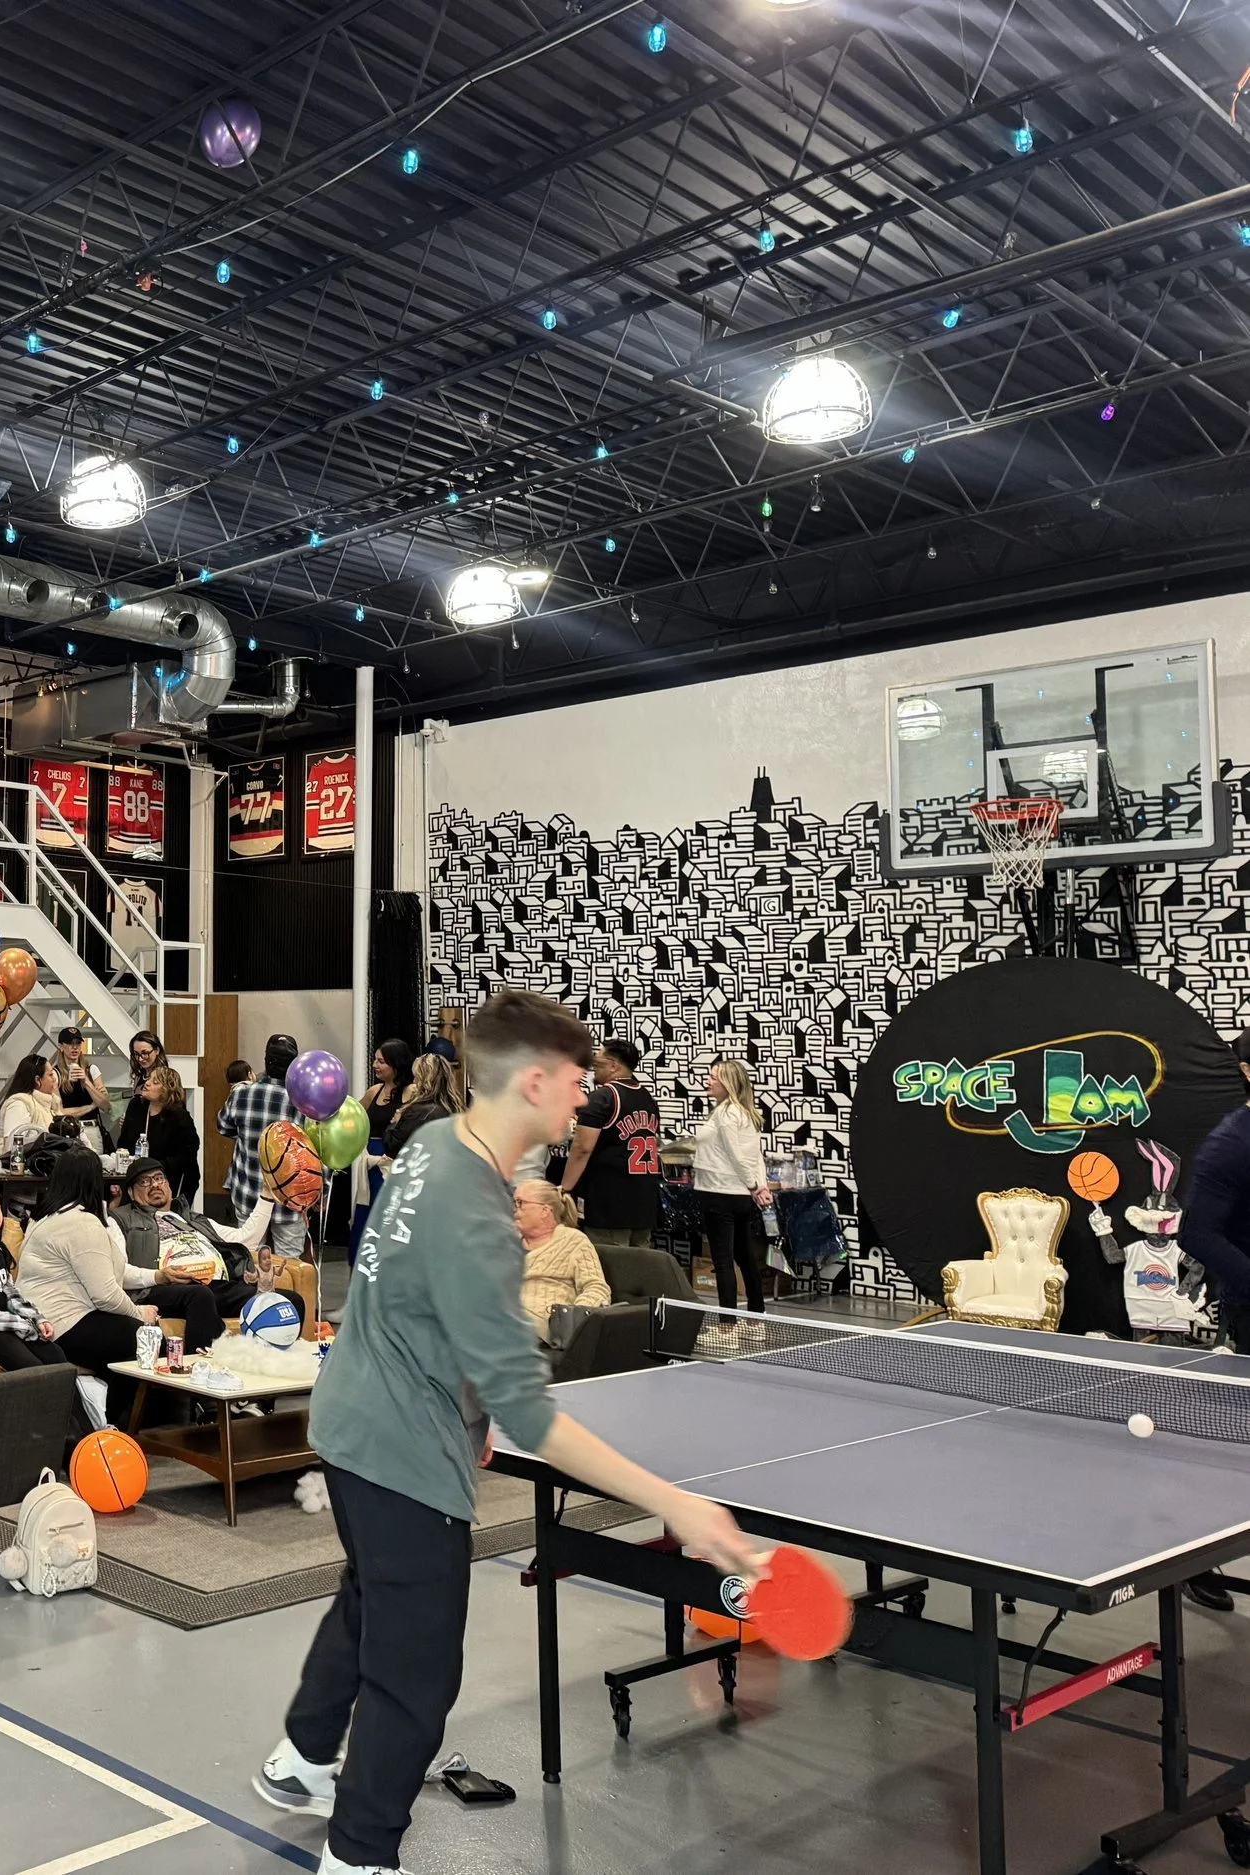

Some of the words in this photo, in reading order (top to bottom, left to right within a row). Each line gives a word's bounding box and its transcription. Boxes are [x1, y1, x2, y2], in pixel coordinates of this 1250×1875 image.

[33, 771, 40, 782] 7
[47, 769, 72, 781] CHELIOS
[109, 775, 121, 787] 88
[323, 773, 349, 786] ROENICK
[79, 777, 86, 788] 7
[130, 779, 144, 789] KANE
[152, 780, 164, 791] 88
[246, 780, 264, 791] CORVO
[305, 781, 319, 793] 27
[52, 782, 68, 809] 7
[123, 790, 149, 823] 88
[240, 791, 271, 825] 77
[320, 785, 353, 821] 27
[125, 894, 148, 906] POLITO
[893, 1057, 1017, 1112] SPACE
[1003, 1049, 1151, 1154] JAM
[627, 1136, 659, 1175] 23
[1108, 1583, 1136, 1608] STIGA
[1106, 1655, 1144, 1685] ADVANTAGE
